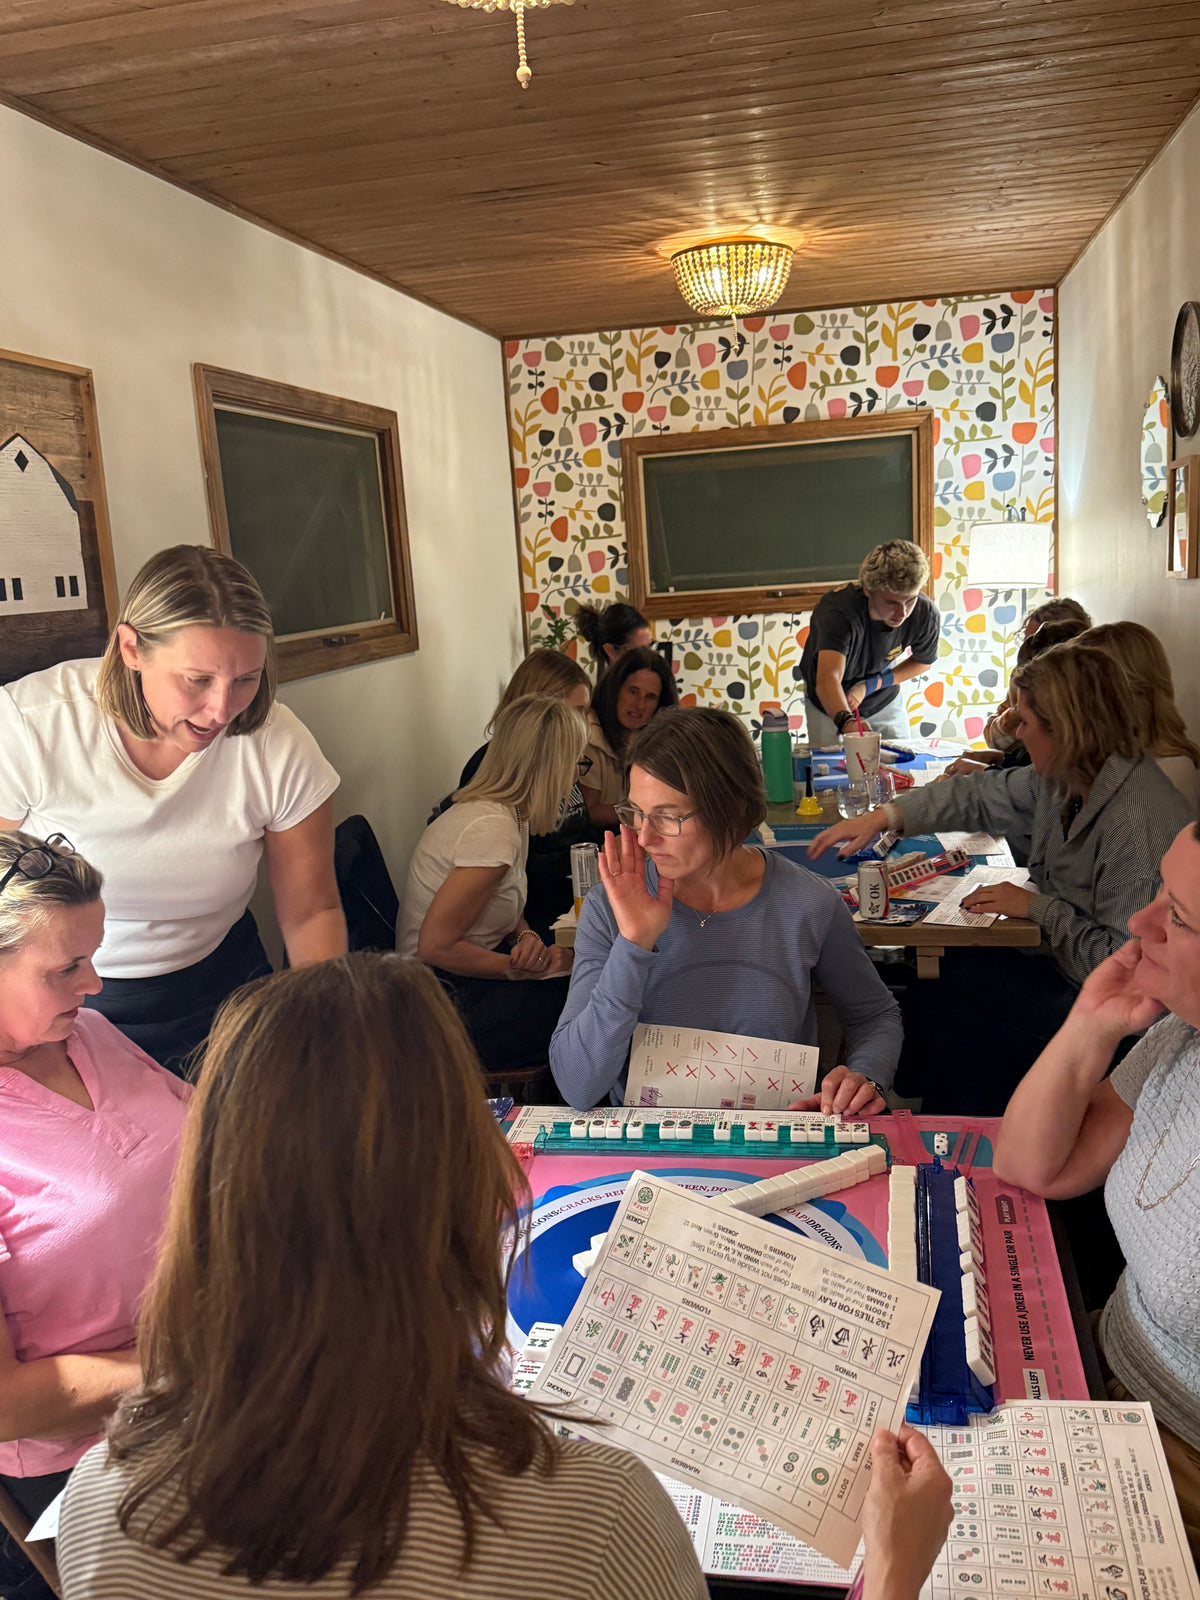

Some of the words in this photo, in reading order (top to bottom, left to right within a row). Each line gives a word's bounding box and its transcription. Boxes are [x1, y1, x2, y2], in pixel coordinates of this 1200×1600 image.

[870, 883, 880, 899] OK
[626, 1214, 645, 1224] JOKER
[1004, 1230, 1014, 1243] PAIR
[706, 1246, 723, 1258] extra
[737, 1242, 762, 1256] DRAGON
[1006, 1244, 1016, 1253] OR
[724, 1253, 736, 1263] any
[743, 1254, 759, 1264] WIND
[736, 1260, 760, 1275] include
[1008, 1255, 1020, 1276] SINGLE
[761, 1270, 772, 1278] not
[773, 1274, 789, 1286] does
[790, 1282, 801, 1291] set
[682, 1297, 710, 1314] FLOWERS
[817, 1294, 837, 1307] PLAY
[1014, 1292, 1029, 1313] JOKER
[837, 1302, 854, 1314] FOR
[865, 1304, 881, 1315] DOTS
[854, 1309, 874, 1323] TILES
[875, 1318, 890, 1329] 152
[1018, 1321, 1030, 1334] USE
[1021, 1336, 1034, 1360] NEVER
[834, 1364, 857, 1379] WINDS
[1029, 1370, 1039, 1384] LEFT
[546, 1381, 571, 1396] DRAGONS
[1032, 1385, 1041, 1400] ALLS
[865, 1400, 876, 1427] CRAKS
[852, 1441, 864, 1462] BAMS
[671, 1457, 700, 1473] NUMBERS
[1059, 1462, 1068, 1485] FLOWERS
[837, 1478, 849, 1499] DOTS
